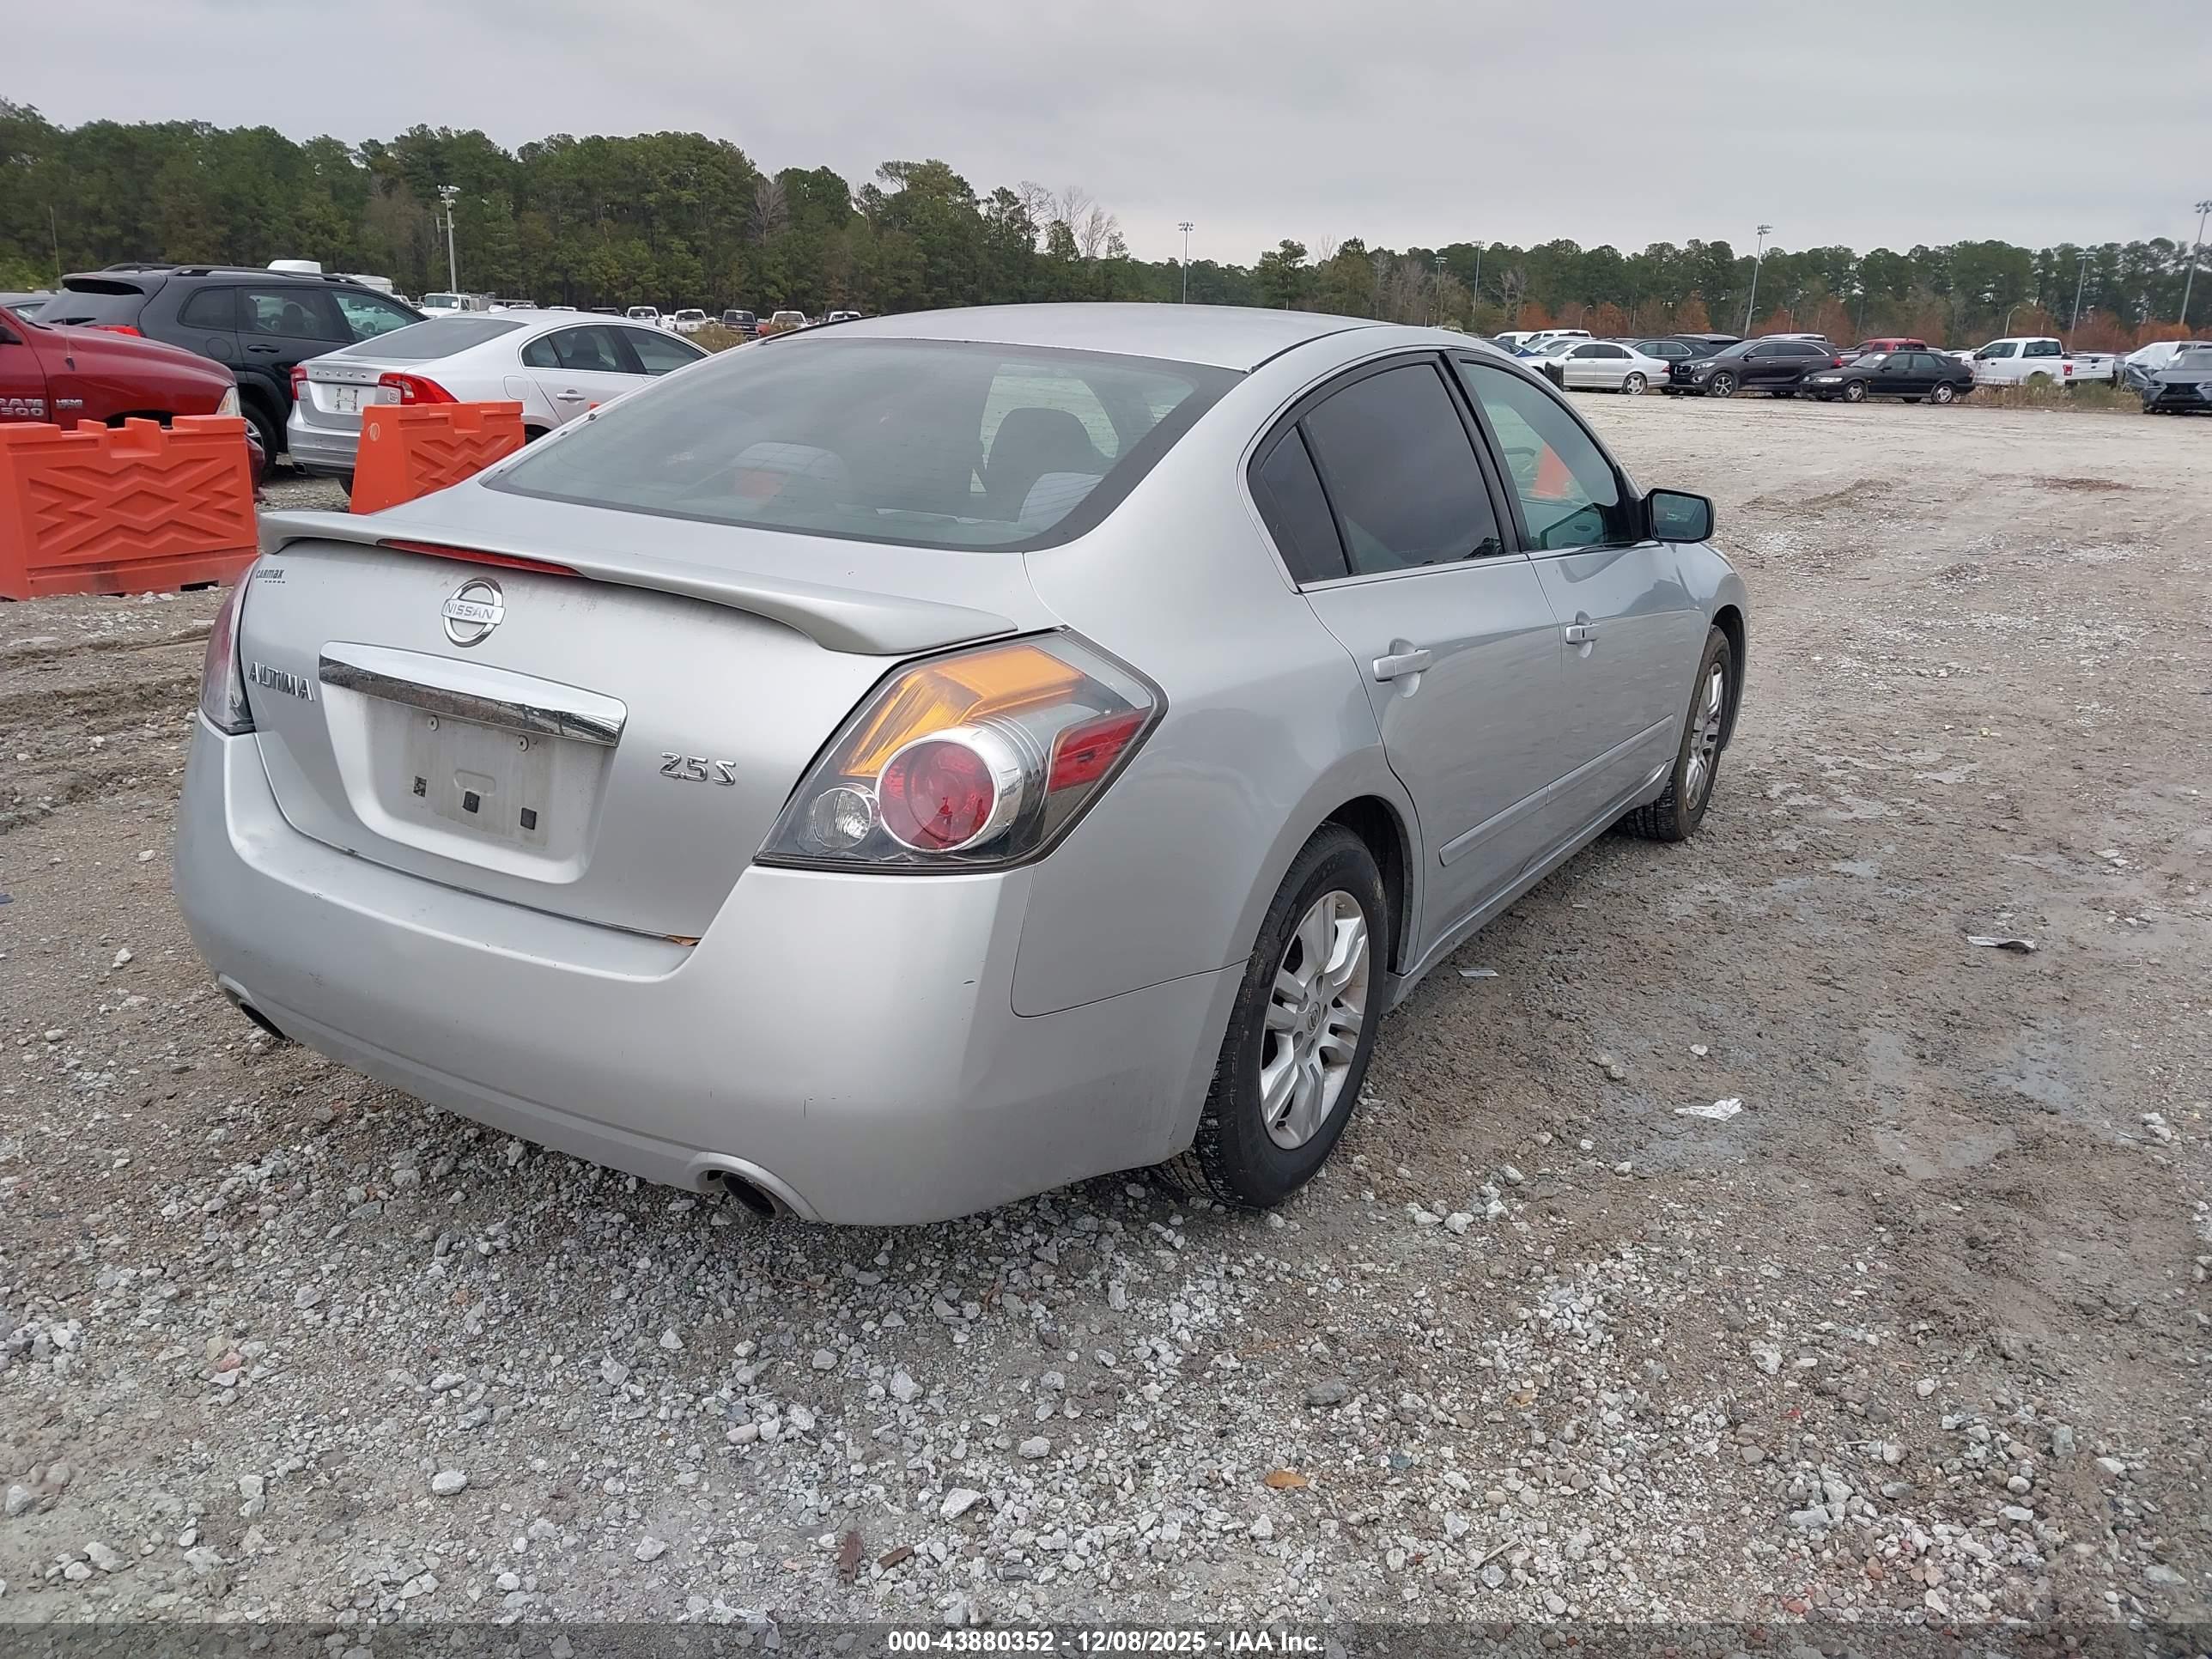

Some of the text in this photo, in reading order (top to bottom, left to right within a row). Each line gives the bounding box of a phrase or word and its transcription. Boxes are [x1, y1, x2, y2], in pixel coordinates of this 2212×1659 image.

[446, 602, 495, 619] NISSAN
[249, 660, 316, 702] ALTIMA
[659, 751, 736, 786] 2.5 S
